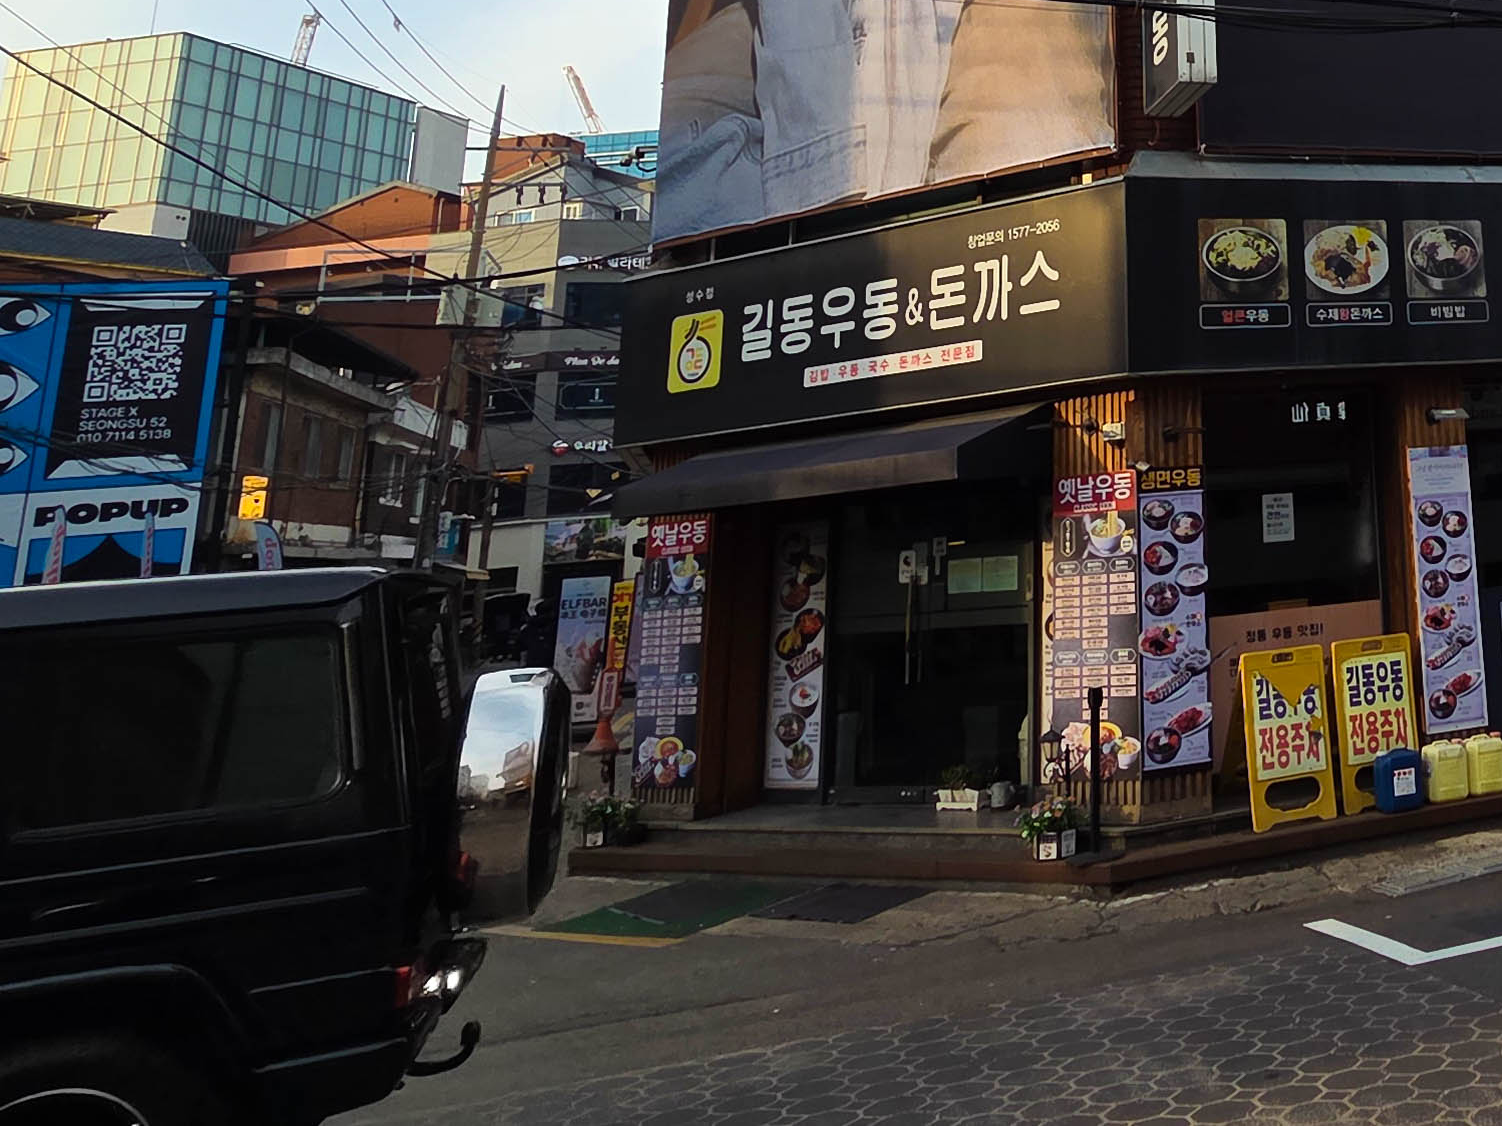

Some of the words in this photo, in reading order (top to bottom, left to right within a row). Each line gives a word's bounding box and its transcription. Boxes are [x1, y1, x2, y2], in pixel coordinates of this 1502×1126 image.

[968, 229, 1004, 249] 창업문의
[1007, 218, 1061, 241] 1577-2056
[685, 286, 715, 304] 성수점
[1221, 308, 1270, 323] 얼큰우동
[1316, 307, 1384, 321] 수제왕돈까스
[1430, 305, 1466, 319] 비빔밥
[837, 363, 860, 379] 우동
[867, 359, 890, 375] 국수
[898, 350, 933, 370] 돈까스
[940, 344, 976, 363] 전문점
[80, 407, 126, 420] STAGE
[128, 406, 139, 417] X
[78, 418, 147, 432] SEONGSU
[149, 416, 168, 428] 52
[76, 432, 103, 444] 010
[105, 430, 135, 442] 7114
[139, 428, 172, 441] 5138
[1058, 472, 1133, 505] 옛날우동
[1140, 467, 1202, 491] 생면우동
[34, 497, 190, 528] POPUP
[651, 520, 707, 548] 옛날우동
[561, 597, 607, 611] ELFBAR
[1271, 625, 1293, 640] 우동
[1296, 622, 1324, 639] 맛집!
[1345, 659, 1405, 708] 길동우동
[1255, 677, 1320, 722] 길동동
[1349, 706, 1408, 757] 전용주차
